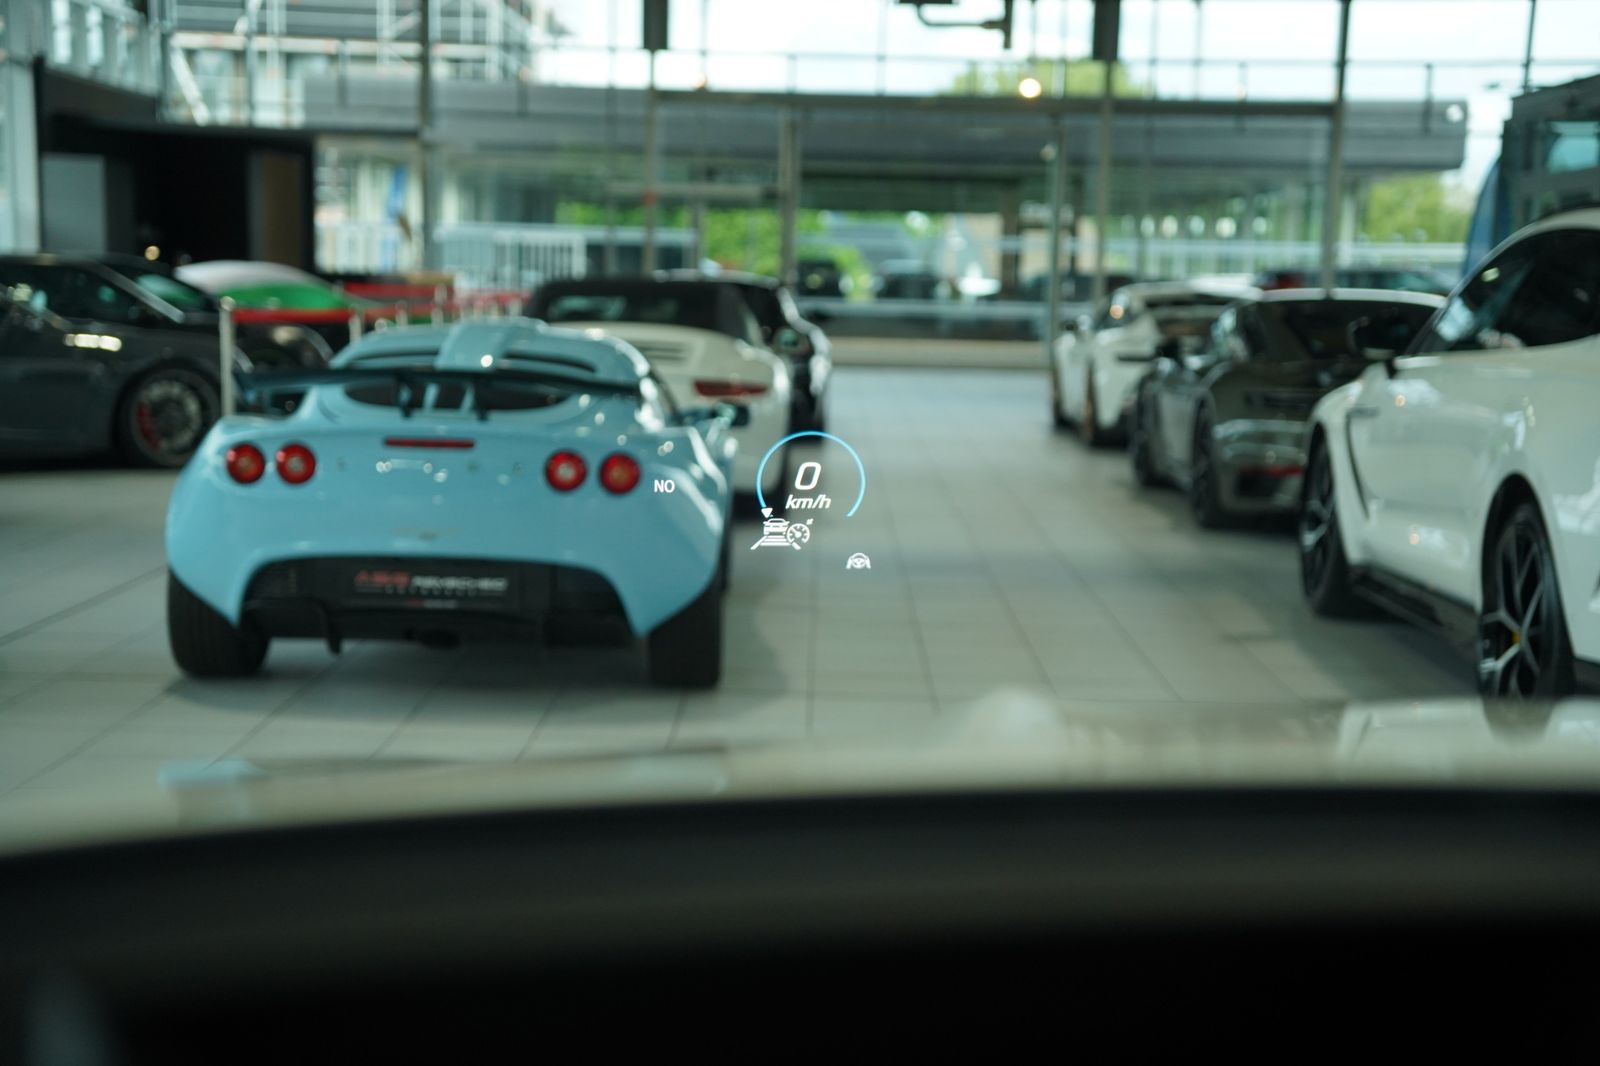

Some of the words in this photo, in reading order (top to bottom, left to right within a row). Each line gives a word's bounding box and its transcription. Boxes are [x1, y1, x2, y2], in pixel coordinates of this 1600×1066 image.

[795, 462, 821, 490] 0
[654, 480, 675, 493] NO
[785, 495, 831, 510] km/h
